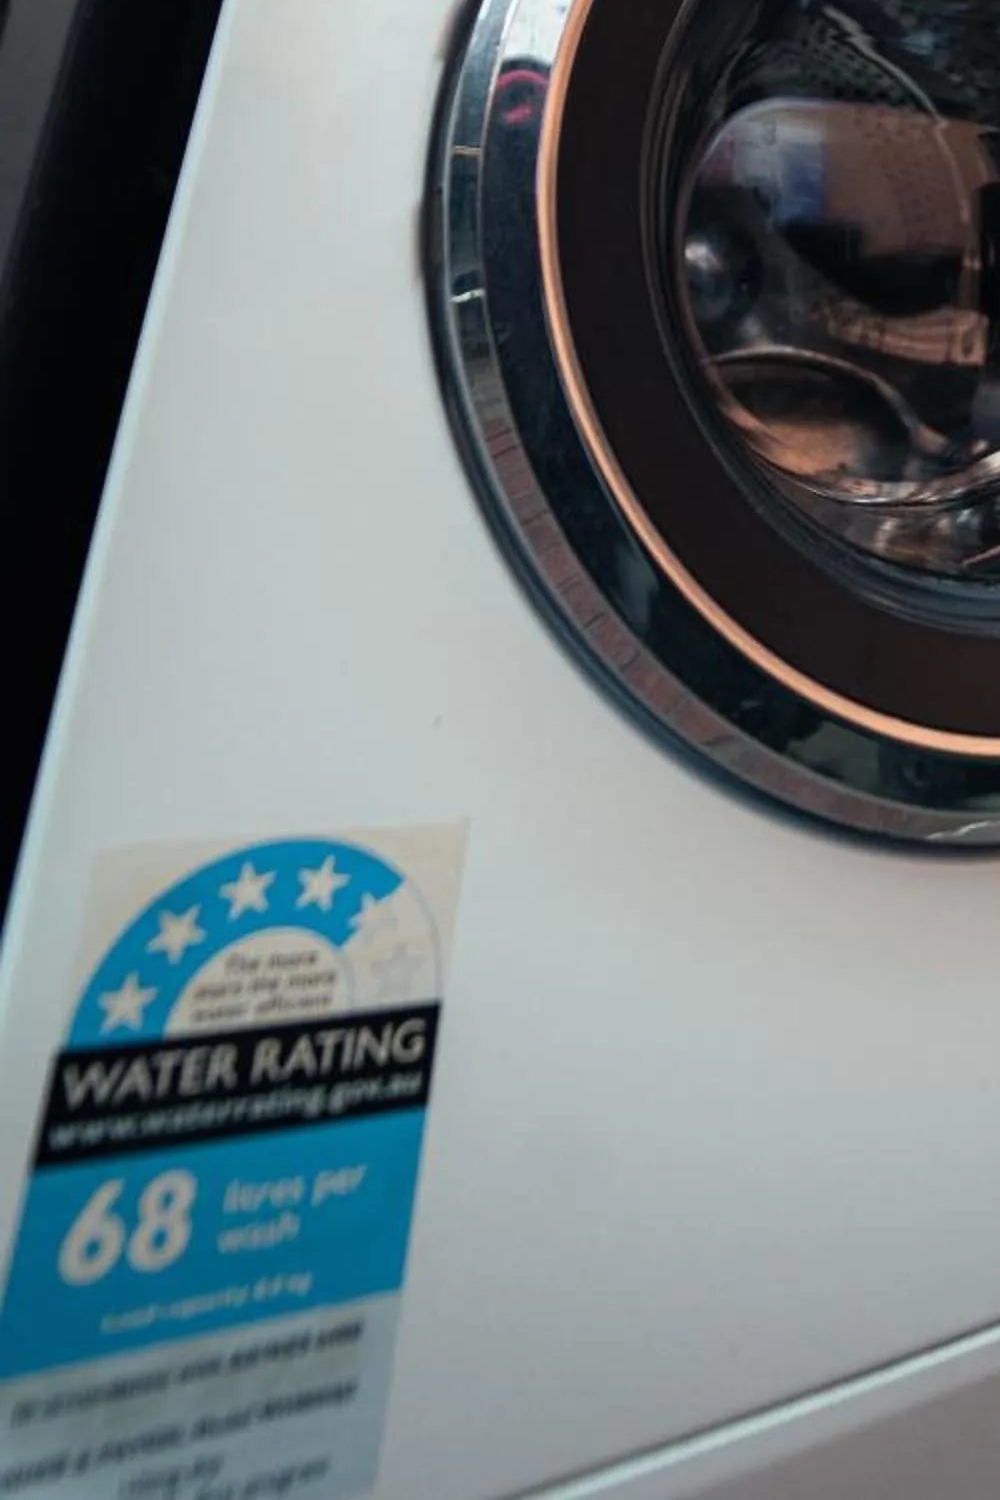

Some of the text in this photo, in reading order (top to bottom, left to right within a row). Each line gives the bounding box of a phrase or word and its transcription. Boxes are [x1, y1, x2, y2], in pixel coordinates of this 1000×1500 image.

[61, 1018, 427, 1111] WATER RATING
[57, 1168, 198, 1287] 68
